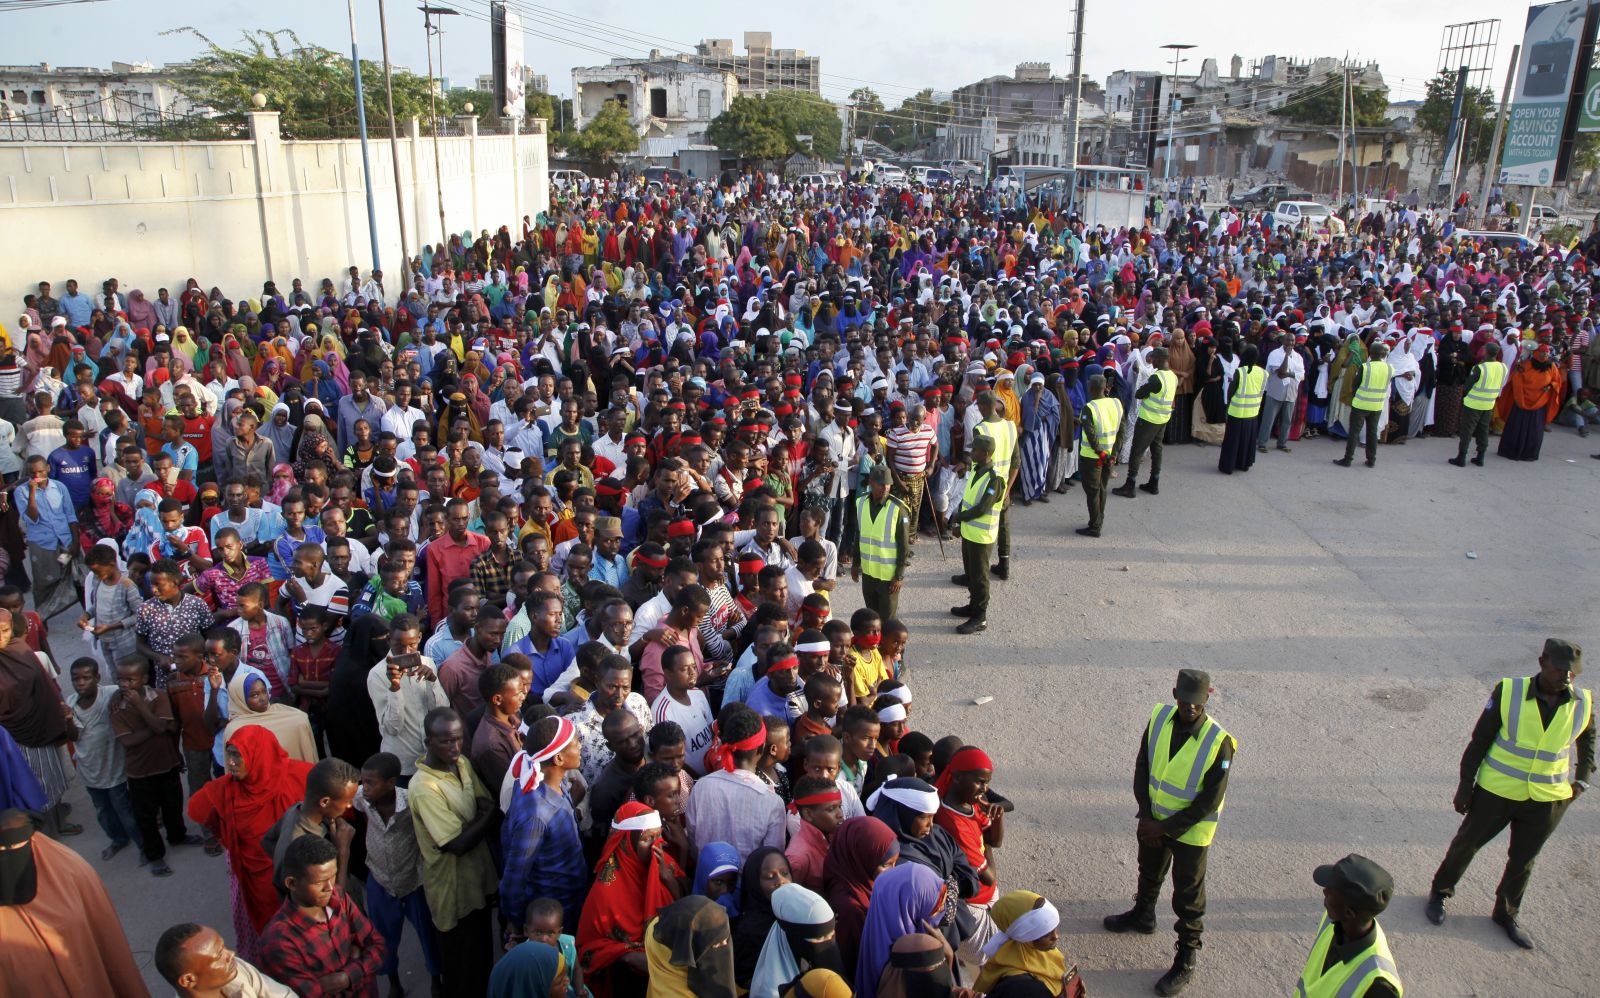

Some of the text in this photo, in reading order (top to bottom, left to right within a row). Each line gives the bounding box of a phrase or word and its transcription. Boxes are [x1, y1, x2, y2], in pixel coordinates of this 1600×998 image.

[1514, 107, 1560, 119] OPEN YOUR
[1512, 119, 1558, 133] SAVINGS
[1510, 134, 1557, 147] ACCOUNT
[1508, 147, 1553, 158] WITH US TODAY
[60, 464, 88, 473] SOMALIA
